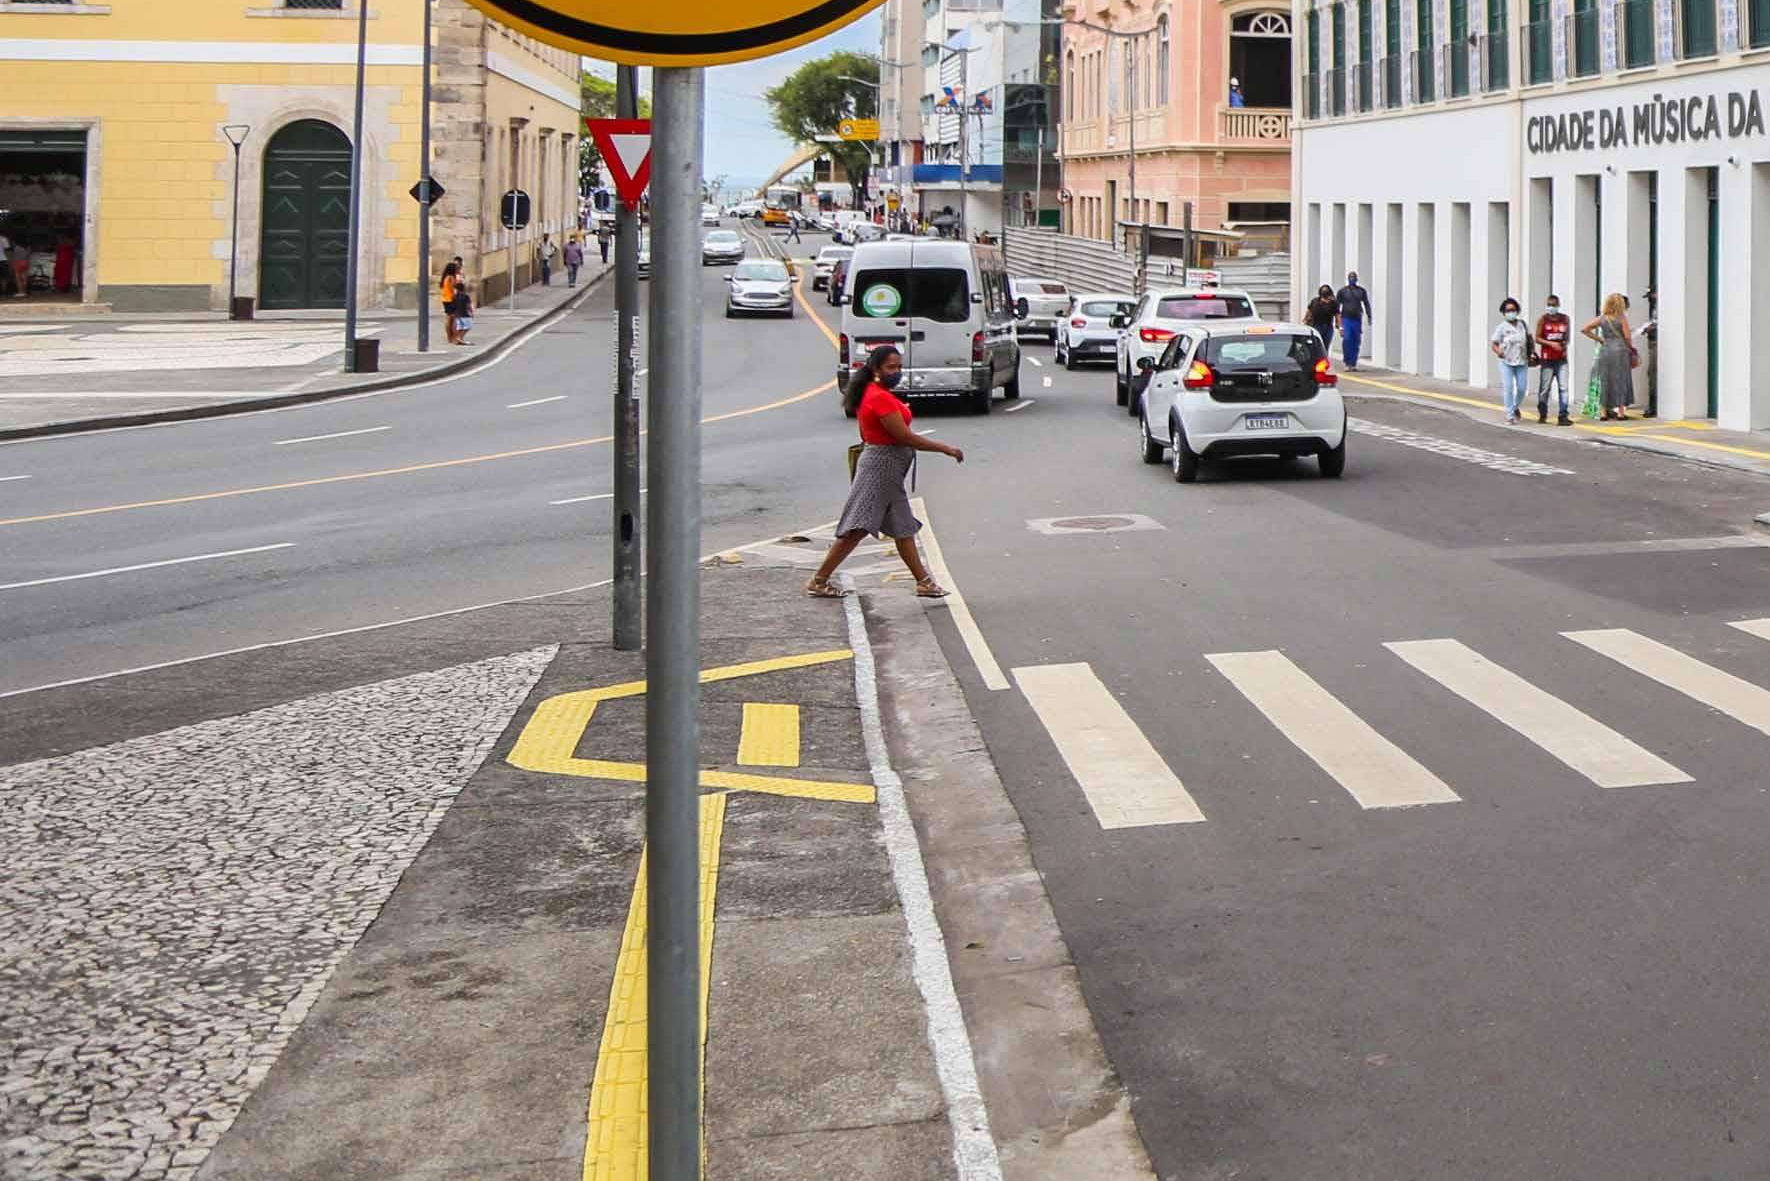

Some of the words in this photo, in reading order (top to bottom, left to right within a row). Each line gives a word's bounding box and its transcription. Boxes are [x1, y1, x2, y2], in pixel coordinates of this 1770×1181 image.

[1527, 110, 1595, 154] CIDADE
[1599, 106, 1629, 149] DA
[1633, 93, 1722, 147] MÚSICA
[1727, 89, 1766, 138] DA
